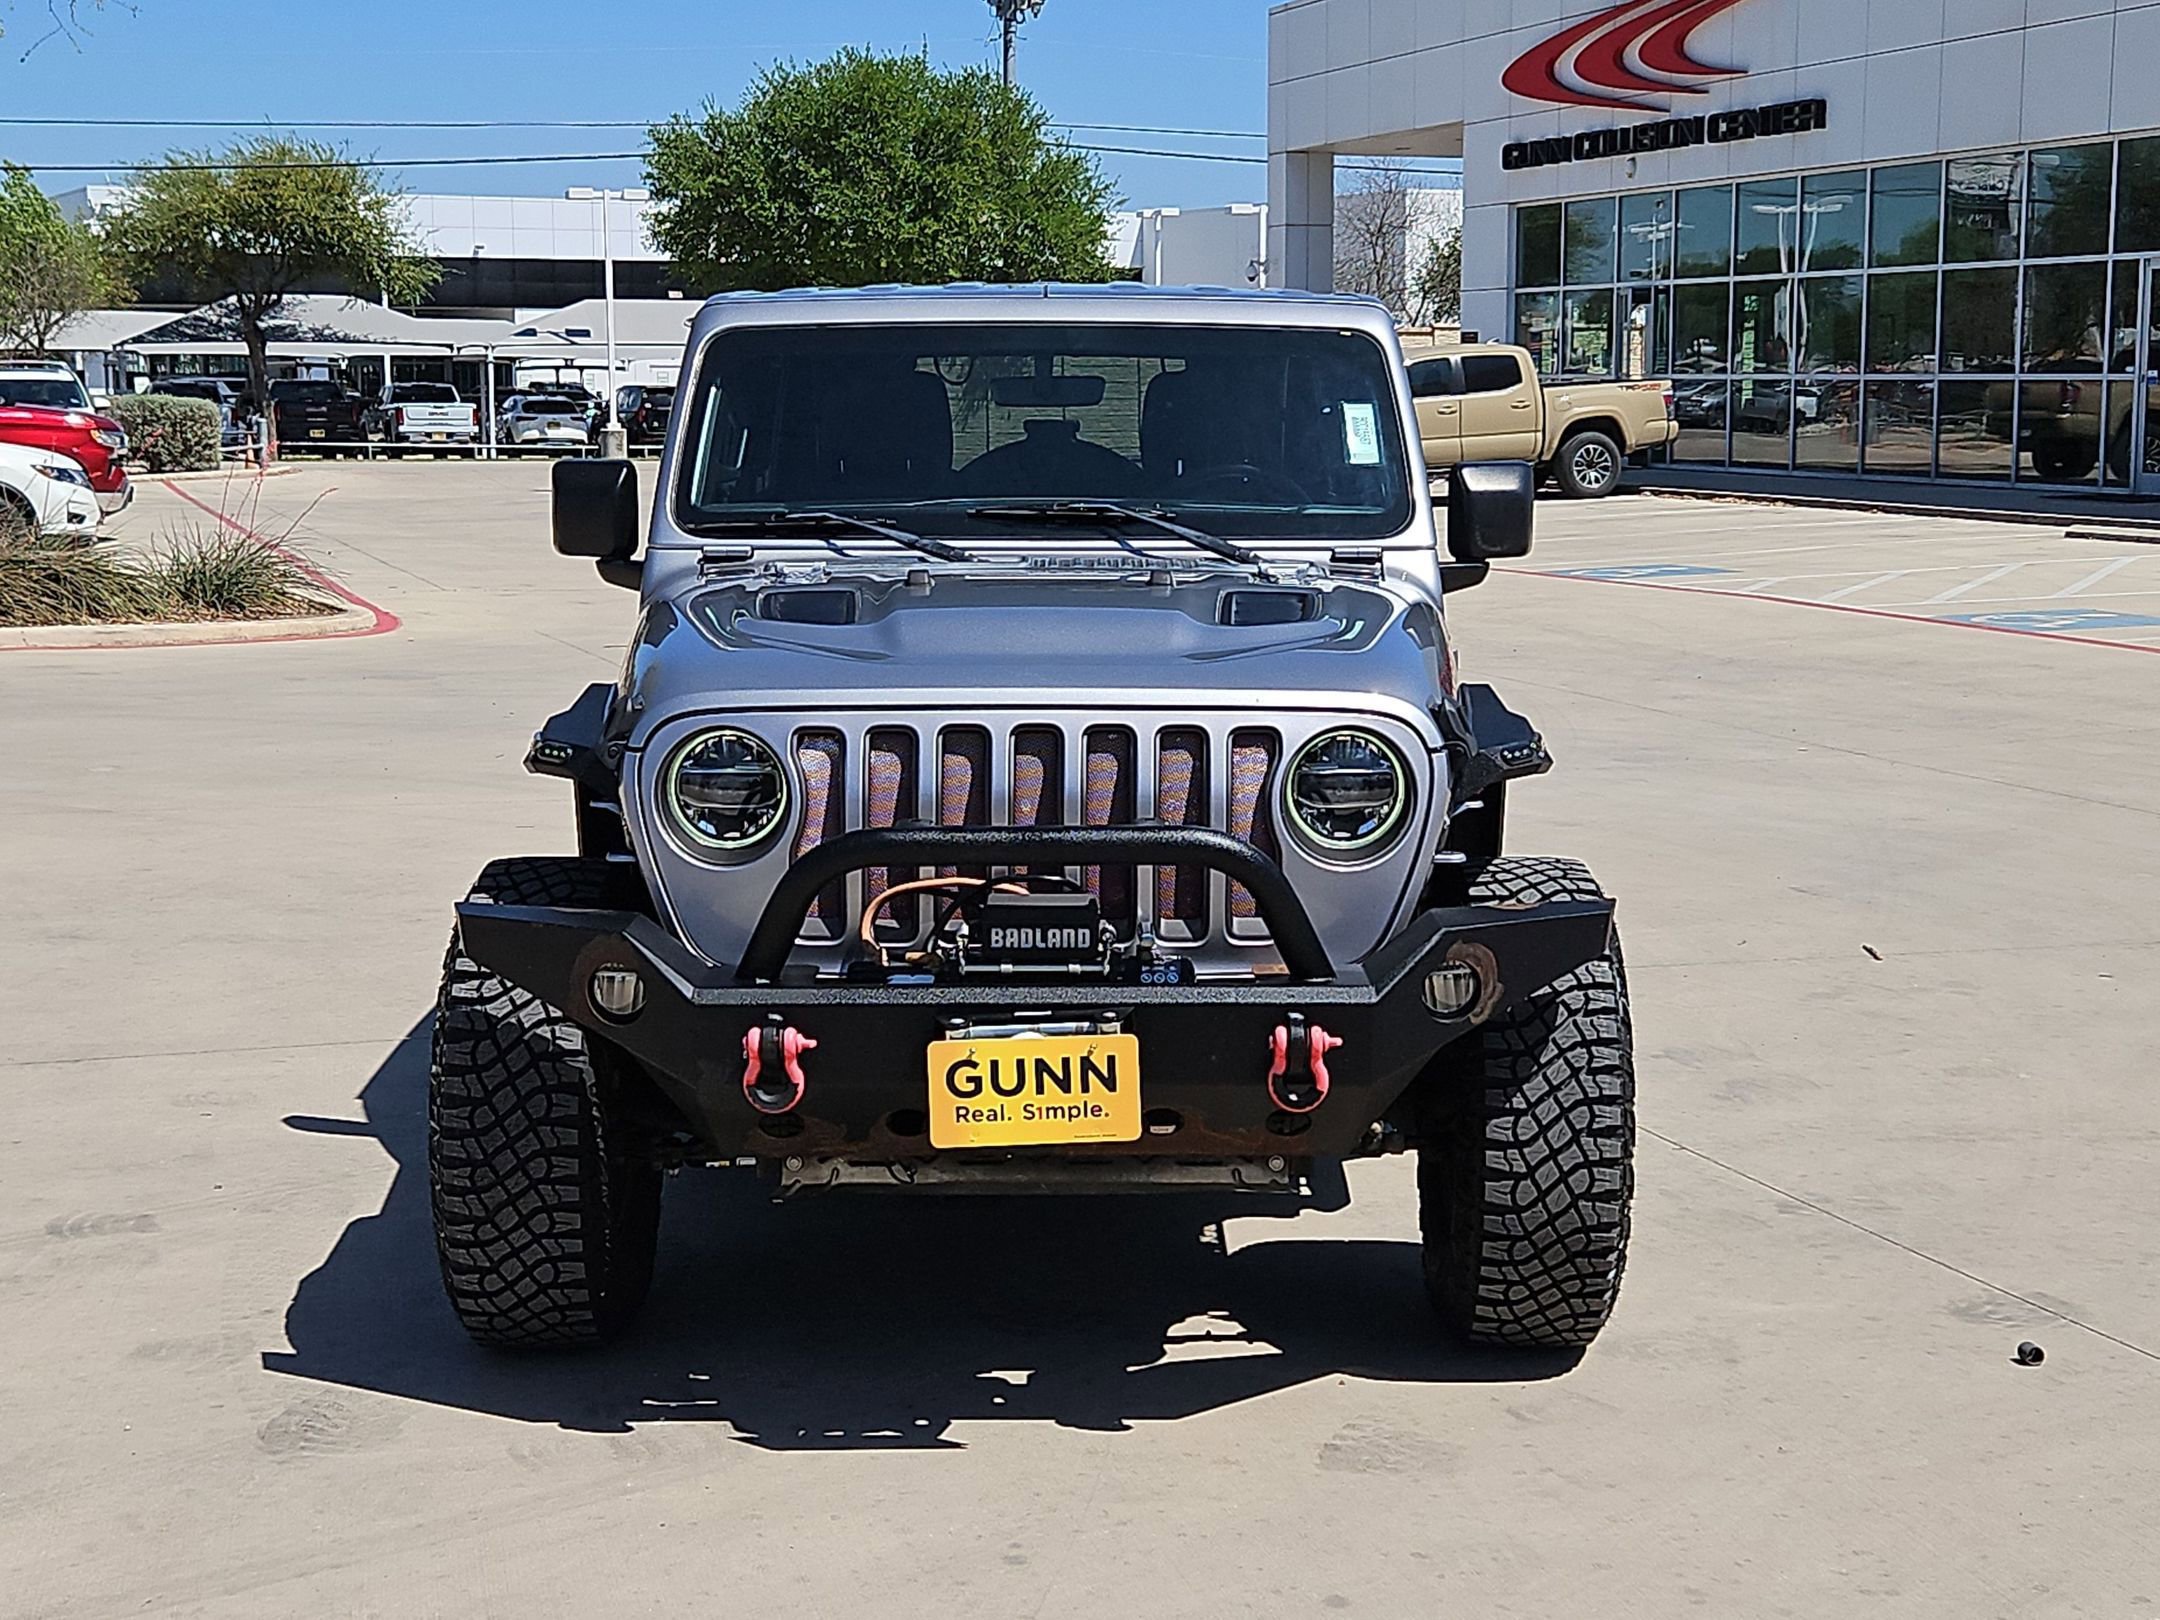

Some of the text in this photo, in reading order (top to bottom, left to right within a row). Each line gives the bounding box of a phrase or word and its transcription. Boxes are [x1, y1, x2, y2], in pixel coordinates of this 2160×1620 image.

[1502, 98, 1827, 170] GUNN COLLISION CENTER
[990, 927, 1090, 949] BADLAND
[945, 1054, 1118, 1099] GUNN
[955, 1103, 1013, 1123] Real.
